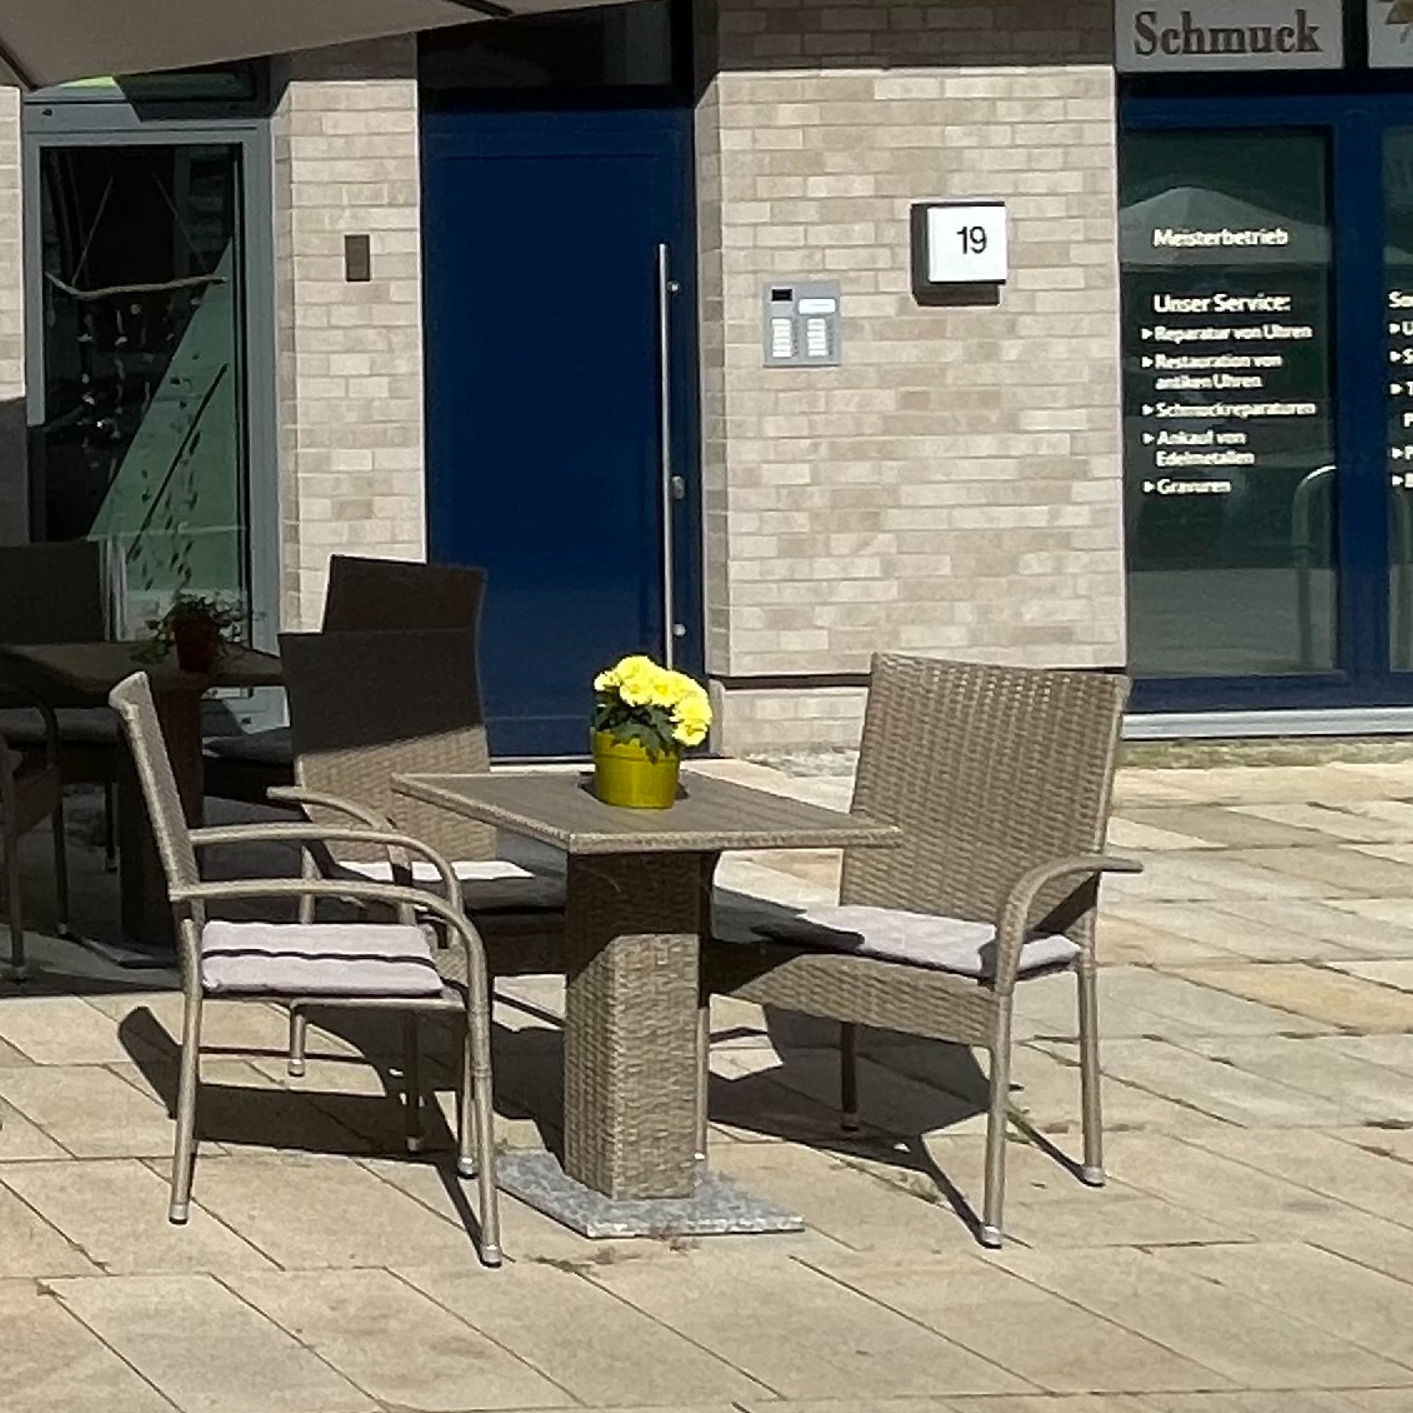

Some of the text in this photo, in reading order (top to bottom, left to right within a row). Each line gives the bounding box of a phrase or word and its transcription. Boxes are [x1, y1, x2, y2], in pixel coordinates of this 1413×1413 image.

[1134, 8, 1323, 57] Schmuck
[956, 226, 987, 255] 19
[1152, 227, 1289, 247] Meisterbetrieb
[1153, 293, 1291, 313] Unser Service:
[1232, 327, 1263, 340] von
[1262, 323, 1313, 340] Uhren
[1212, 373, 1263, 389] Uhren
